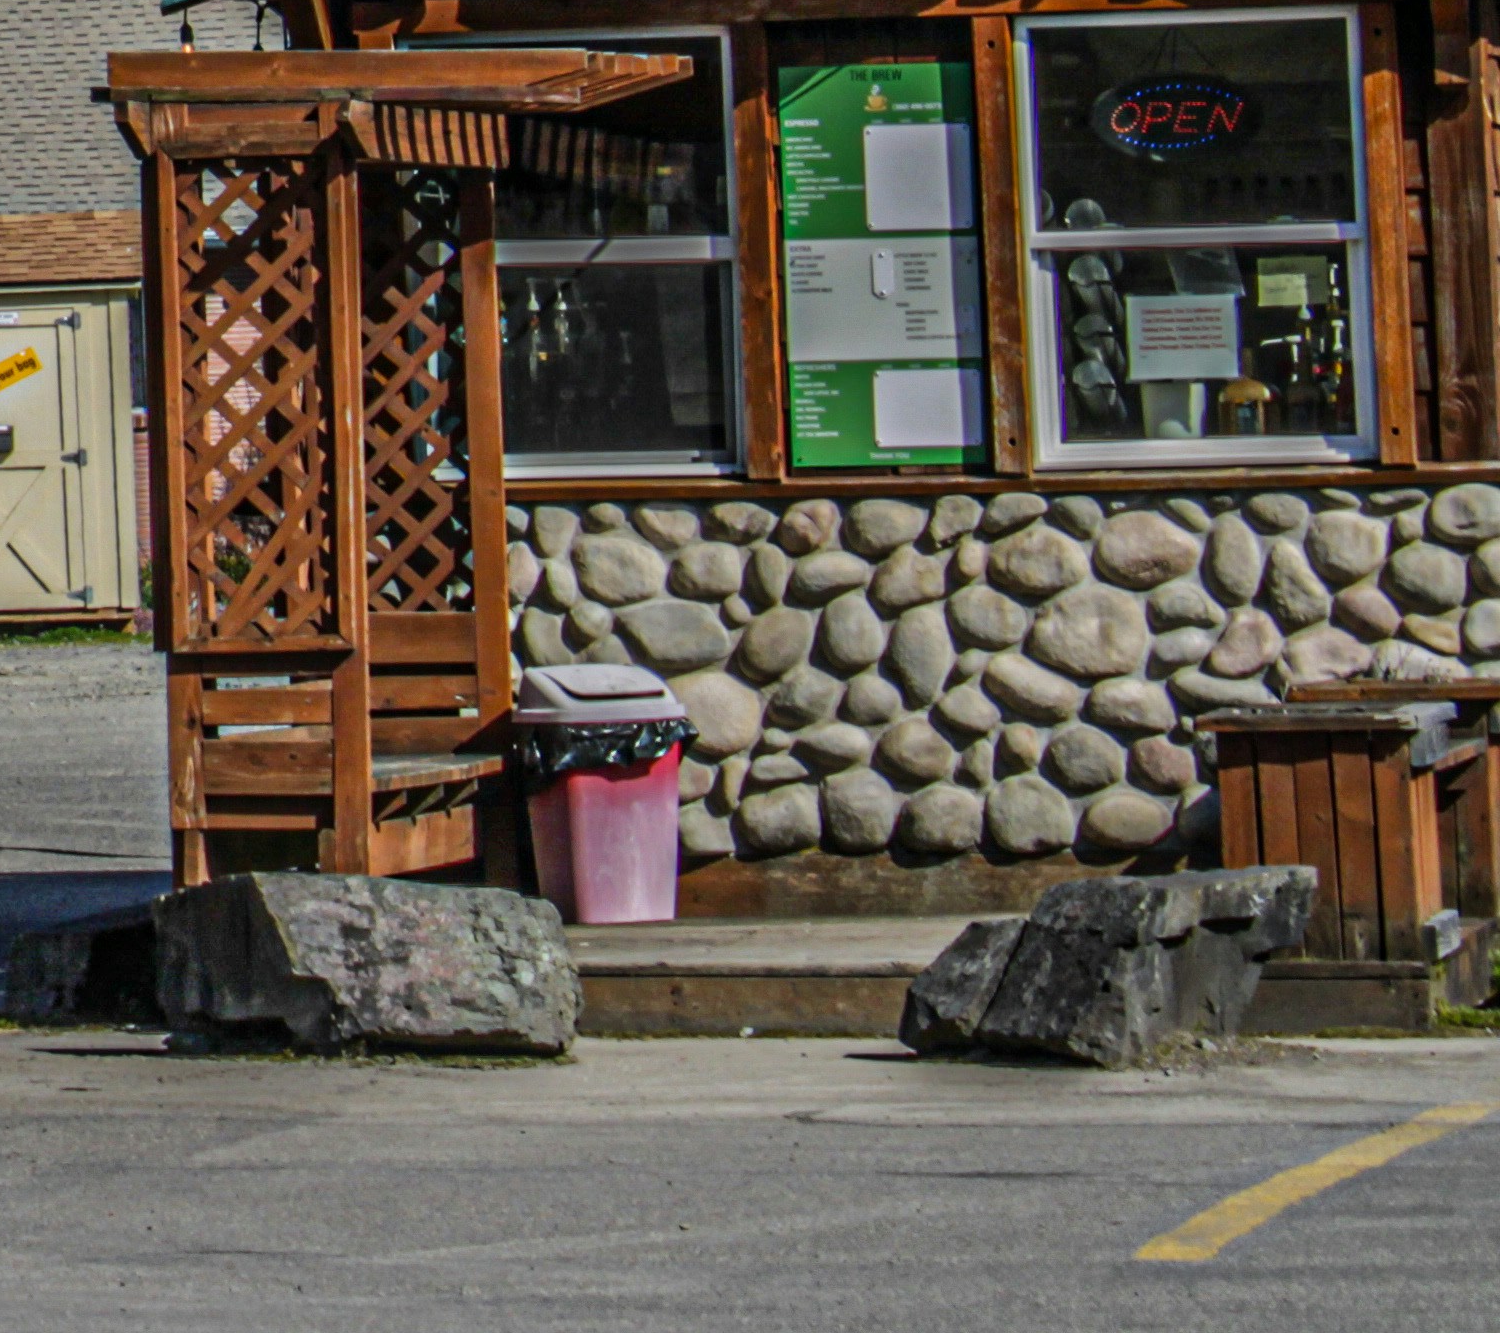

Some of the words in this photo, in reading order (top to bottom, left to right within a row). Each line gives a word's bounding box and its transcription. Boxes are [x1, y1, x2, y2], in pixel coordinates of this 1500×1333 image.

[850, 69, 867, 81] THE
[871, 68, 903, 81] BREW
[1110, 101, 1245, 133] OPEN
[14, 358, 38, 373] bag
